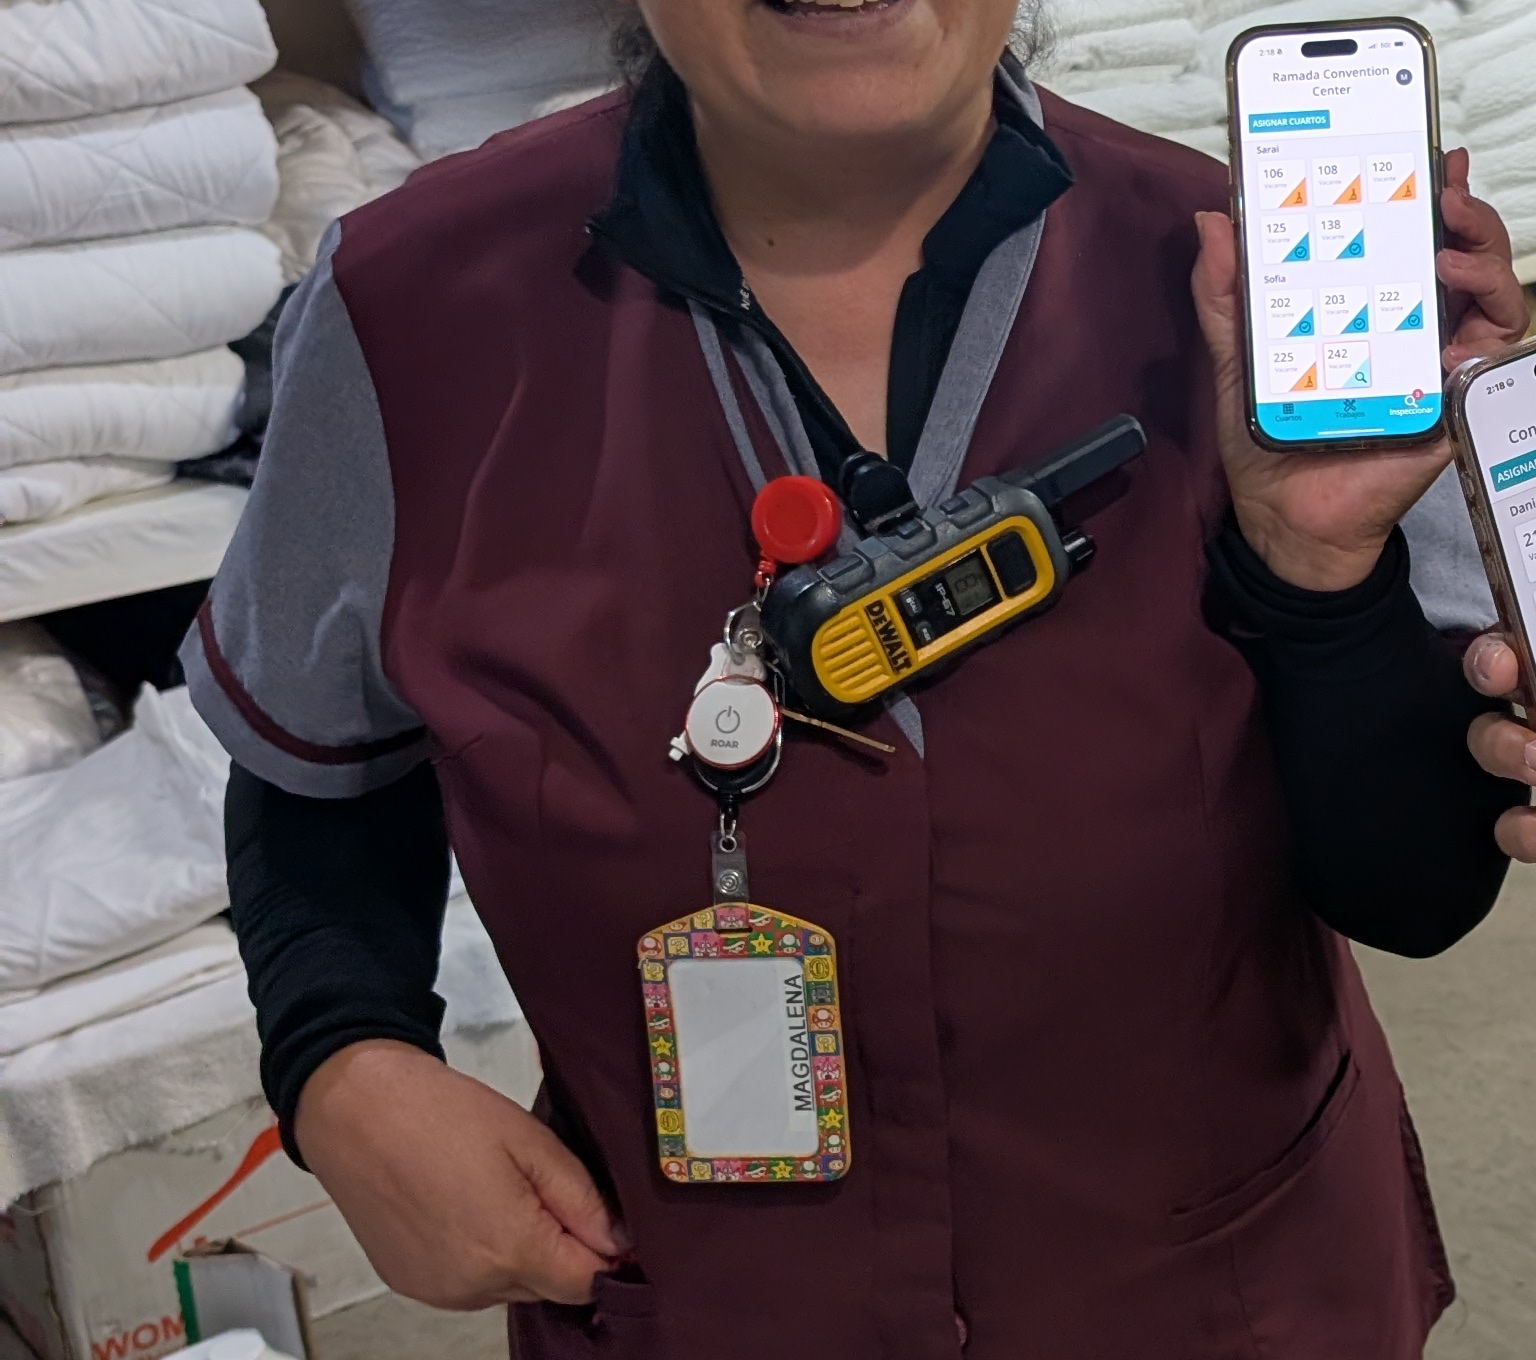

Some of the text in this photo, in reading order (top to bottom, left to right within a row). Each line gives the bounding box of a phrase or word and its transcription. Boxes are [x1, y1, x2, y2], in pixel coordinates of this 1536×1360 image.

[1259, 48, 1275, 57] 2:18
[1272, 66, 1390, 82] Ramada Convention
[1400, 73, 1409, 81] M
[1312, 85, 1352, 97] Center
[1252, 115, 1327, 128] ASIGNAR CUARTOS
[1256, 145, 1280, 154] Sarai
[1263, 161, 1393, 179] 106 108 120
[1266, 219, 1341, 233] 125 138
[1264, 274, 1286, 284] Sofia
[1270, 291, 1400, 308] 202 203 222
[1273, 348, 1348, 362] 225 242
[1486, 381, 1506, 395] 2:18
[1275, 414, 1302, 422] Cuartos
[1389, 406, 1434, 416] Inspeccionar
[711, 739, 739, 748] ROAR
[784, 974, 813, 1111] MAGDALENA
